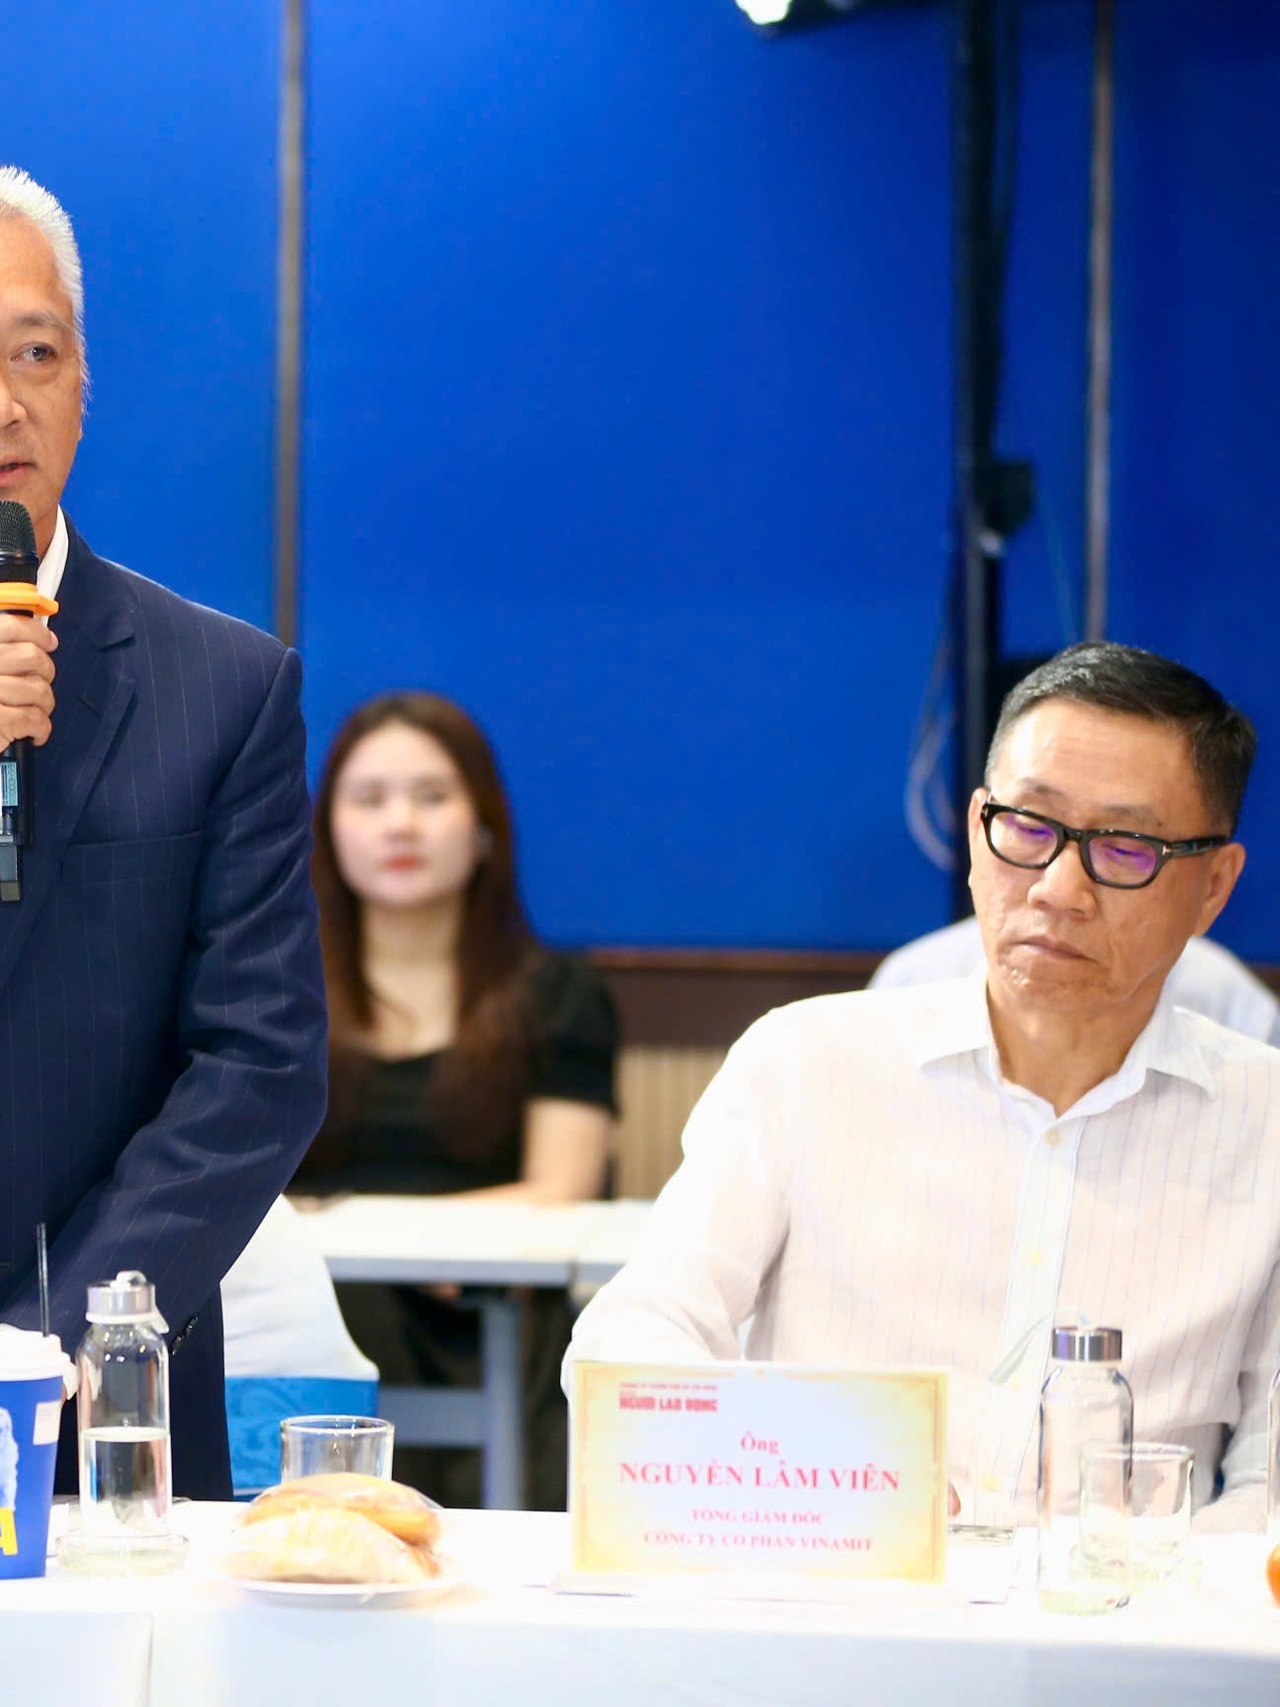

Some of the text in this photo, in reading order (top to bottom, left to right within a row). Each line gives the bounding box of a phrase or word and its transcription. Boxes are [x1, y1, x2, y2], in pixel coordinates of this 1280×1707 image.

[740, 1430, 780, 1456] Ông
[753, 1461, 819, 1489] LÂM
[827, 1463, 900, 1491] VIÊN
[698, 1532, 717, 1547] TY
